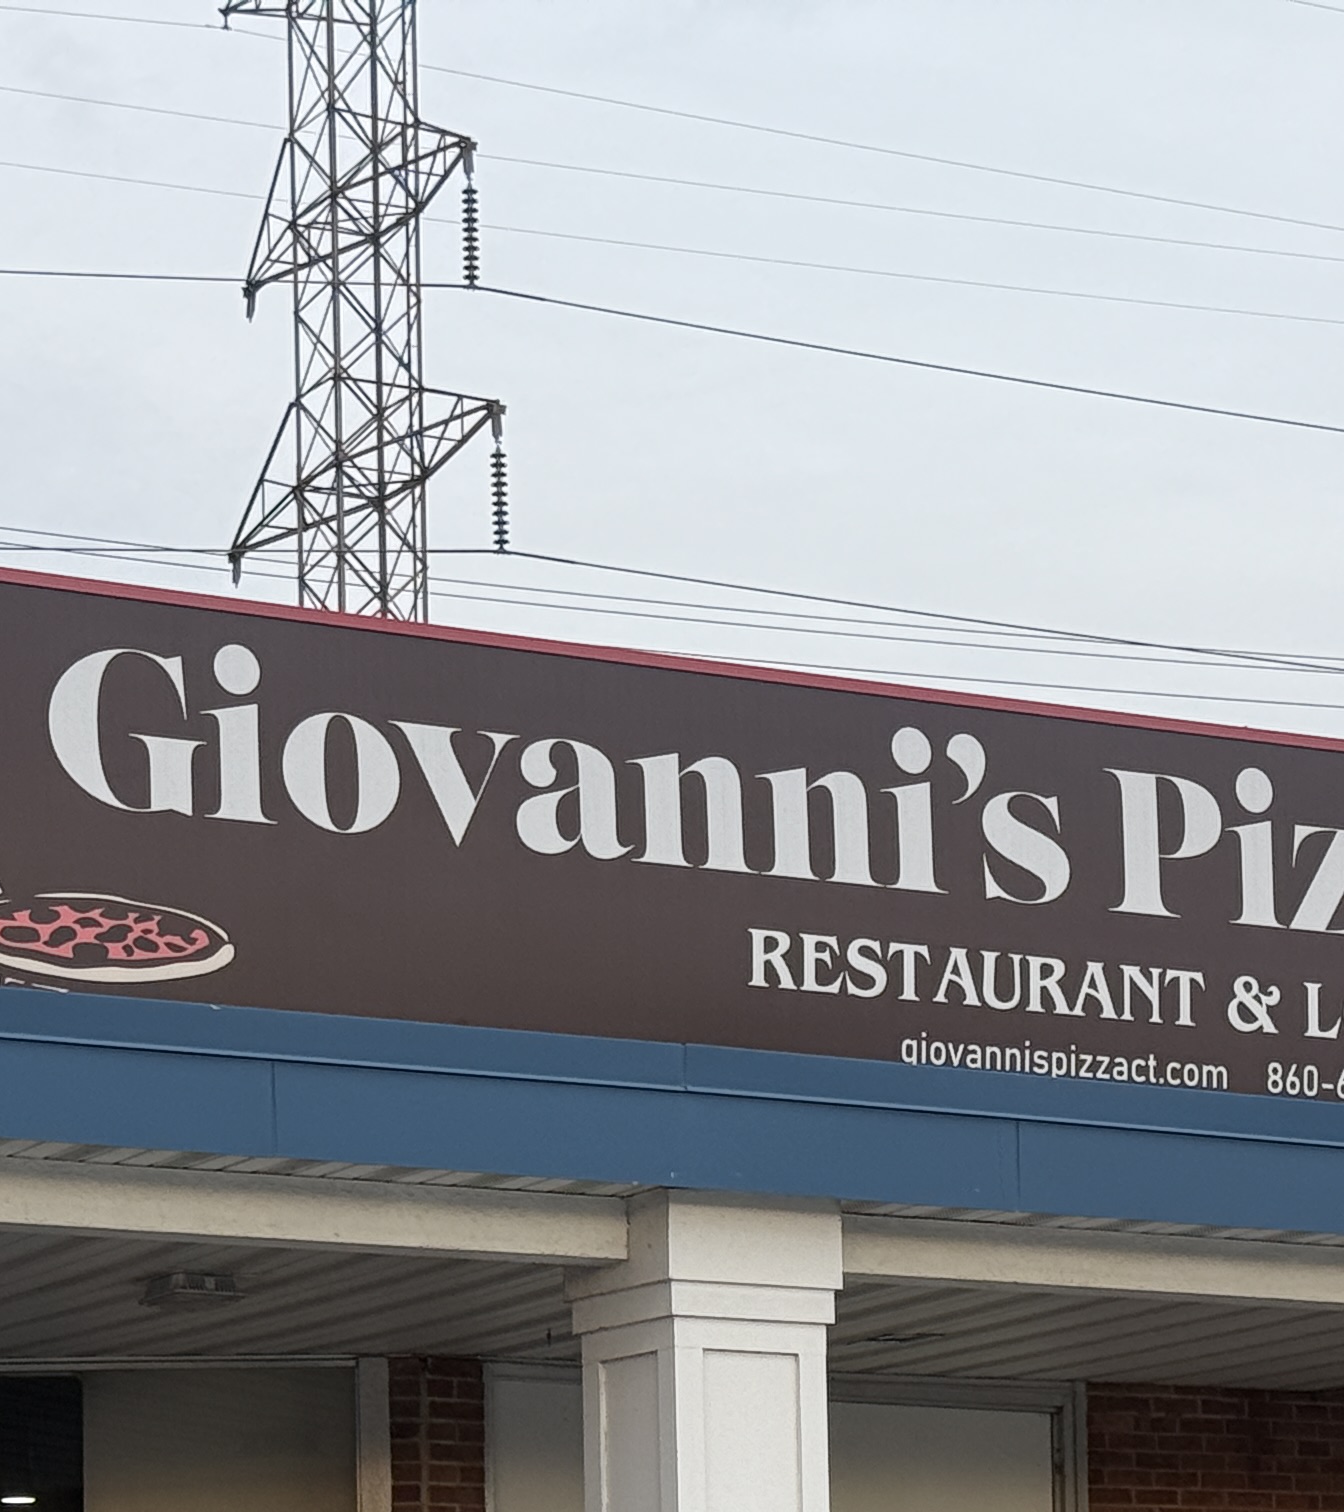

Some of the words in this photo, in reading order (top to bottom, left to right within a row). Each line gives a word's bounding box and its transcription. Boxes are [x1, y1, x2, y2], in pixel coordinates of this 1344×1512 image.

[47, 642, 1072, 904] Giovanni's
[747, 926, 1206, 1028] RESTAURANT
[1226, 974, 1282, 1034] &
[900, 1031, 1229, 1091] giovannispizzact.com
